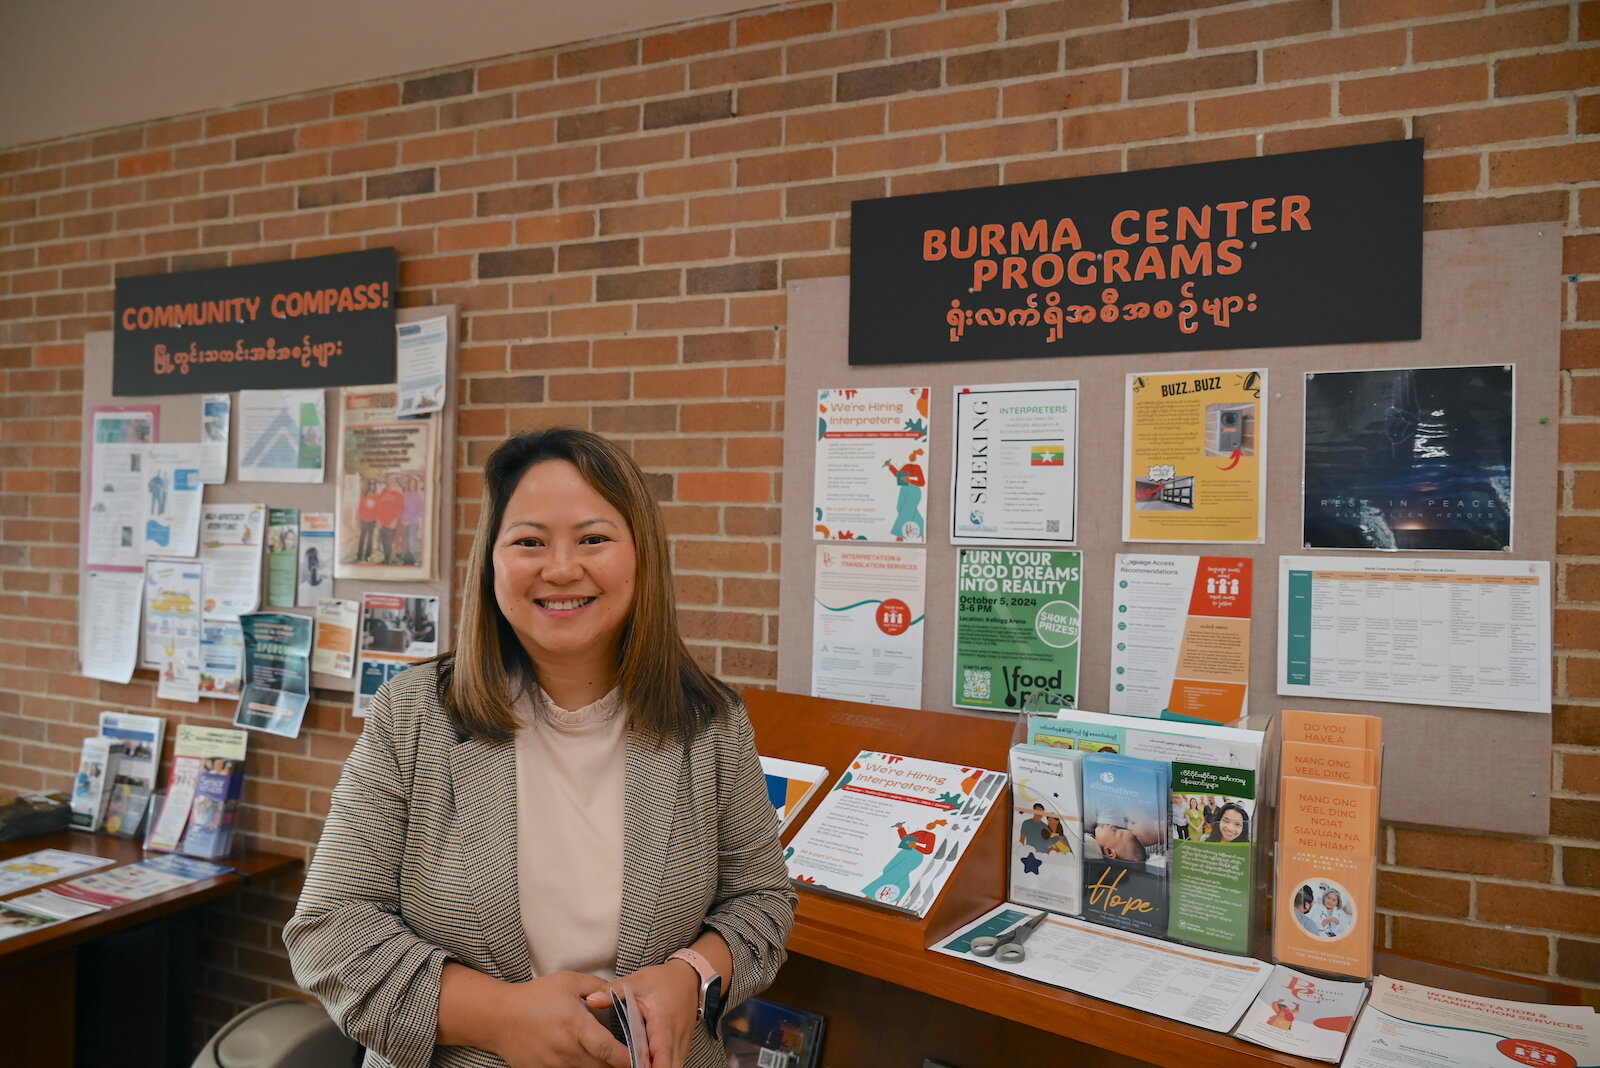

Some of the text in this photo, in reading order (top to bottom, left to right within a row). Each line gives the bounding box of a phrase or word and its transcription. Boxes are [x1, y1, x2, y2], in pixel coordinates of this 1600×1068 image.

[923, 195, 1311, 262] BURMA CENTER
[973, 239, 1244, 292] PROGRAMS
[122, 281, 389, 331] COMMUNITY COMPASS!
[1161, 376, 1221, 397] BUZZ..BUZZ
[830, 402, 903, 414] We're Hiring
[999, 405, 1068, 415] INTERPRETERS
[828, 416, 901, 427] Interpreters
[969, 401, 989, 504] SEEKING
[1390, 499, 1407, 507] IN
[1428, 499, 1495, 508] PEACE
[961, 550, 1051, 566] TURN YOUR
[1152, 560, 1175, 568] Access
[960, 563, 1079, 581] FOOD DREAMS
[1120, 567, 1178, 577] Recommendations
[960, 577, 1067, 595] INTO REALITY
[959, 603, 992, 613] 3-6 PM
[960, 595, 1037, 607] October 5, 2024
[985, 616, 1008, 625] Kellogg
[1040, 611, 1079, 627] $40K IN
[1039, 621, 1078, 636] PRIZES!
[1012, 665, 1062, 692] food
[1304, 722, 1346, 734] DO YOU
[1304, 734, 1345, 744] HAVE A
[1295, 755, 1351, 769] NANG ONG
[865, 762, 947, 787] We're Hiring
[1294, 766, 1351, 780] VEEL DING
[856, 773, 938, 795] Interpreters
[1089, 780, 1139, 798] alternatives
[1299, 793, 1358, 808] NANG ONG
[1299, 805, 1357, 819] VEEL DING
[1311, 816, 1344, 829] NGIAT
[1293, 825, 1361, 842] SIAVUAN NA
[1299, 838, 1355, 854] NEI HIAM?
[1087, 865, 1154, 917] Hope
[1427, 991, 1530, 1017] INTERPRETATION
[1427, 996, 1584, 1032] TRANSLATION SERVICES
